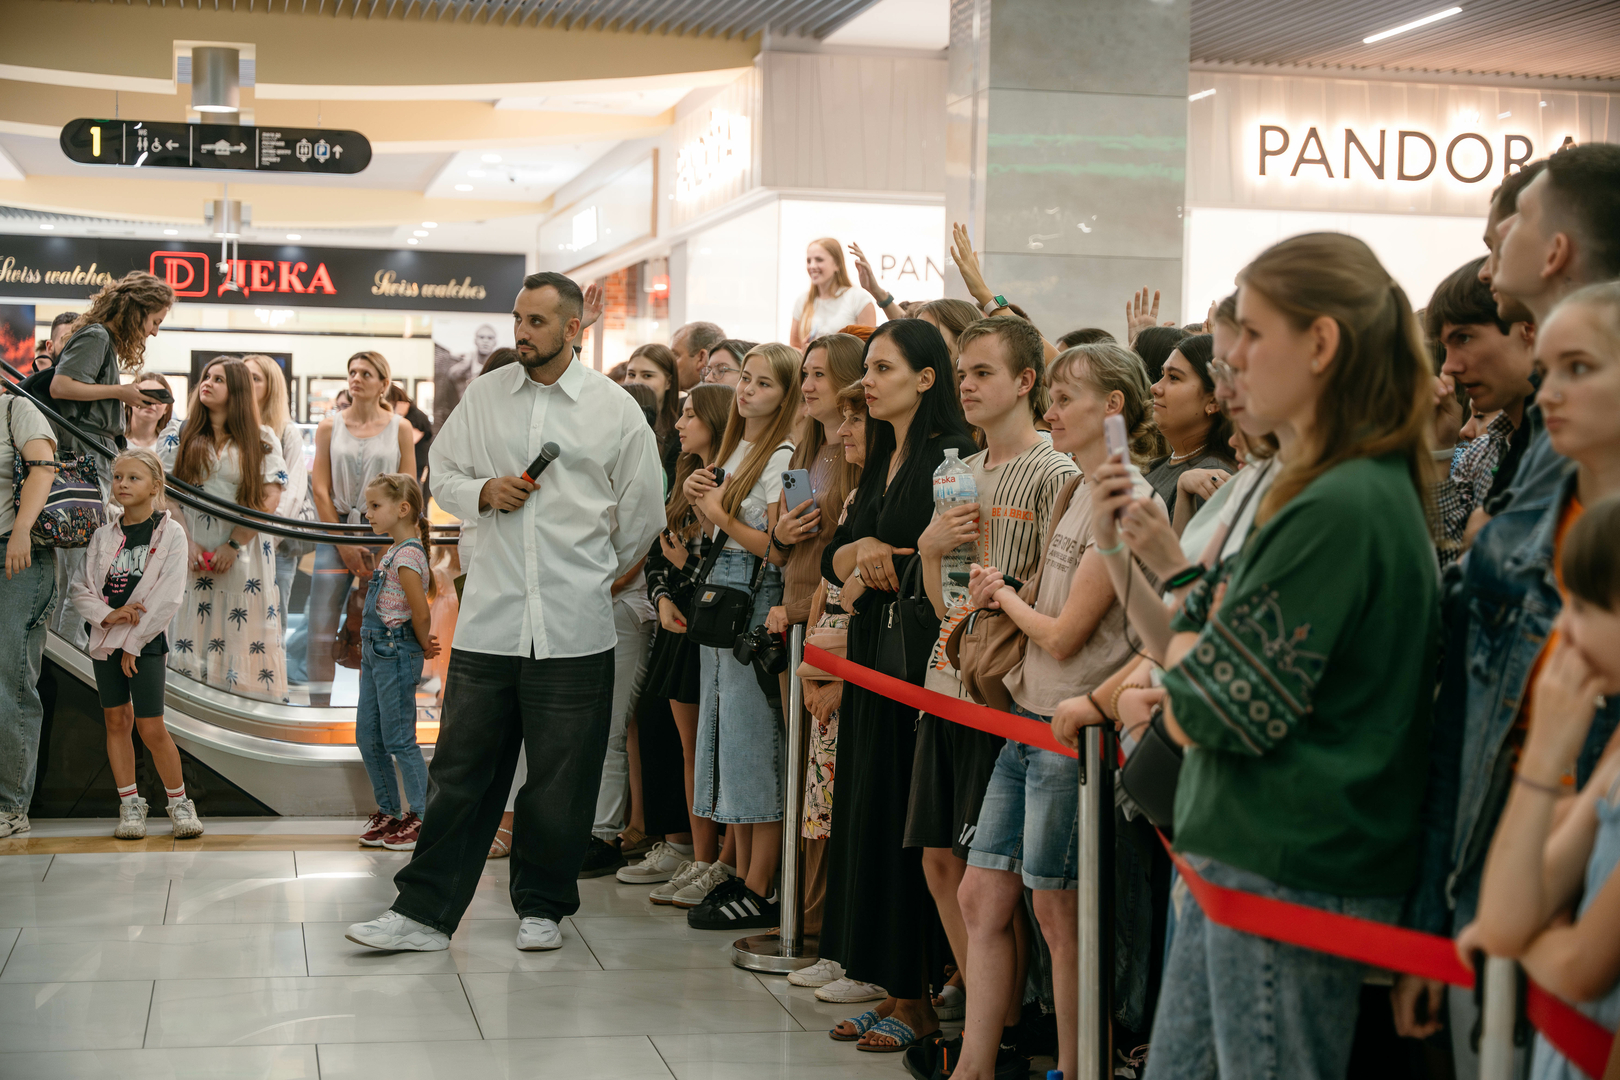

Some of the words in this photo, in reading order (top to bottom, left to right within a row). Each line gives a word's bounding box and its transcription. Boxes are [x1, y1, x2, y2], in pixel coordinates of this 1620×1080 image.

[90, 126, 101, 157] 1
[1259, 125, 1577, 184] PANDOR
[0, 256, 42, 284] Swiss
[217, 258, 338, 298] ДЕКА
[371, 268, 420, 297] Swiss
[991, 507, 1002, 517] BE
[1003, 507, 1008, 517] A
